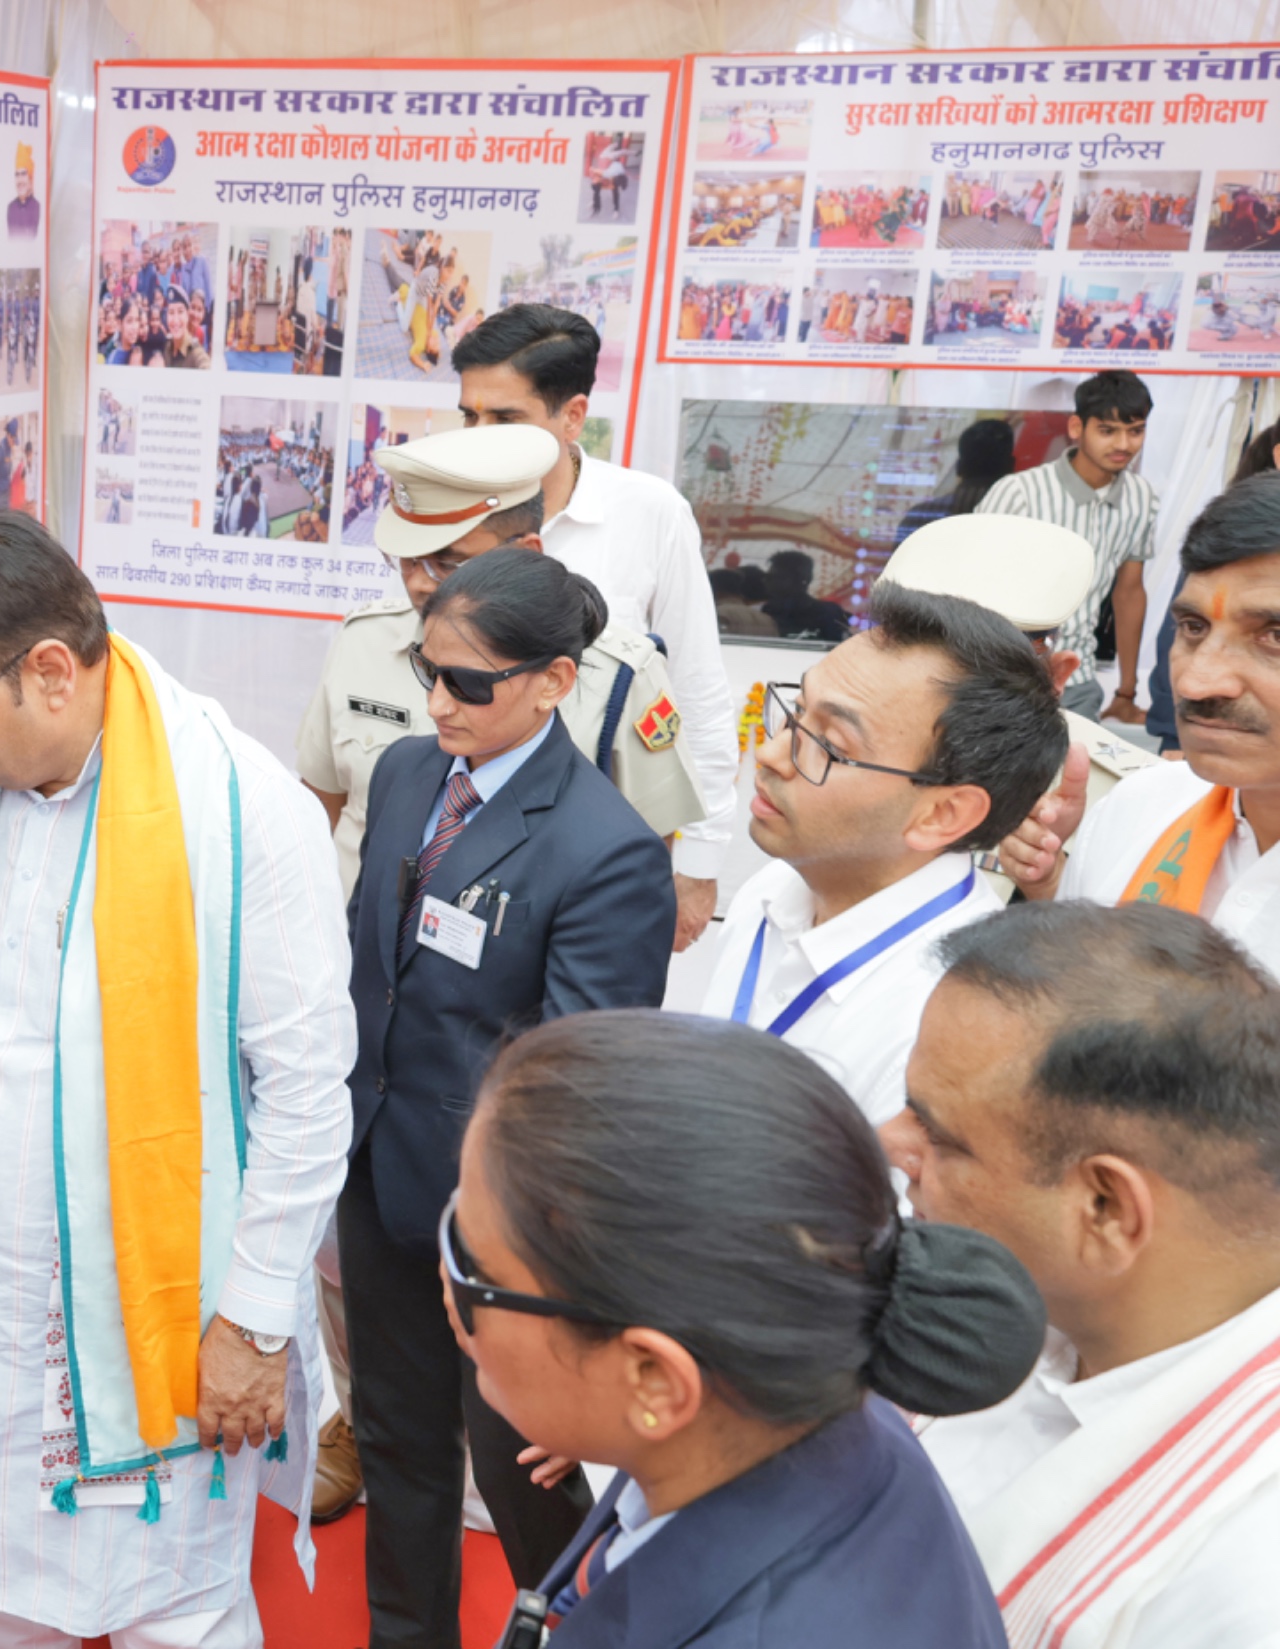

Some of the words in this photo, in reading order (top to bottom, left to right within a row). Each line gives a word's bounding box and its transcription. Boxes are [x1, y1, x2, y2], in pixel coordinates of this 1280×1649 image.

[710, 63, 898, 88] राजस्थान
[906, 60, 1056, 85] सरकार
[1063, 59, 1158, 83] द्वारा
[111, 86, 267, 113] राजस्थान
[273, 89, 397, 115] सरकार
[404, 91, 482, 116] द्वारा
[488, 83, 650, 119] संचालित
[845, 102, 913, 136] सुरक्षा
[914, 93, 1003, 126] सखियों
[1002, 93, 1040, 126] को
[1042, 100, 1156, 125] आत्मरक्षा
[1163, 92, 1269, 125] प्रशिक्षण
[195, 130, 251, 158] आत्म
[254, 131, 298, 159] रक्षा
[375, 126, 453, 163] योजना
[454, 127, 479, 163] के
[481, 128, 571, 165] अन्तर्गत
[1078, 132, 1166, 169] पुलिस
[214, 180, 326, 206] राजस्थान
[331, 172, 406, 218] पुलिस
[411, 185, 541, 221] हनुमानगढ़
[151, 538, 182, 559] जिला
[183, 541, 220, 567] पुलिस
[252, 552, 275, 567] अब
[276, 554, 299, 569] तक
[301, 556, 325, 578] कुल
[326, 558, 342, 574] 34
[345, 560, 377, 577] हजार
[95, 565, 120, 579] सात
[121, 561, 168, 584] दिवसीय
[169, 572, 192, 587] 290
[194, 568, 244, 591] प्रशिक्षण
[315, 583, 349, 599] जाकर
